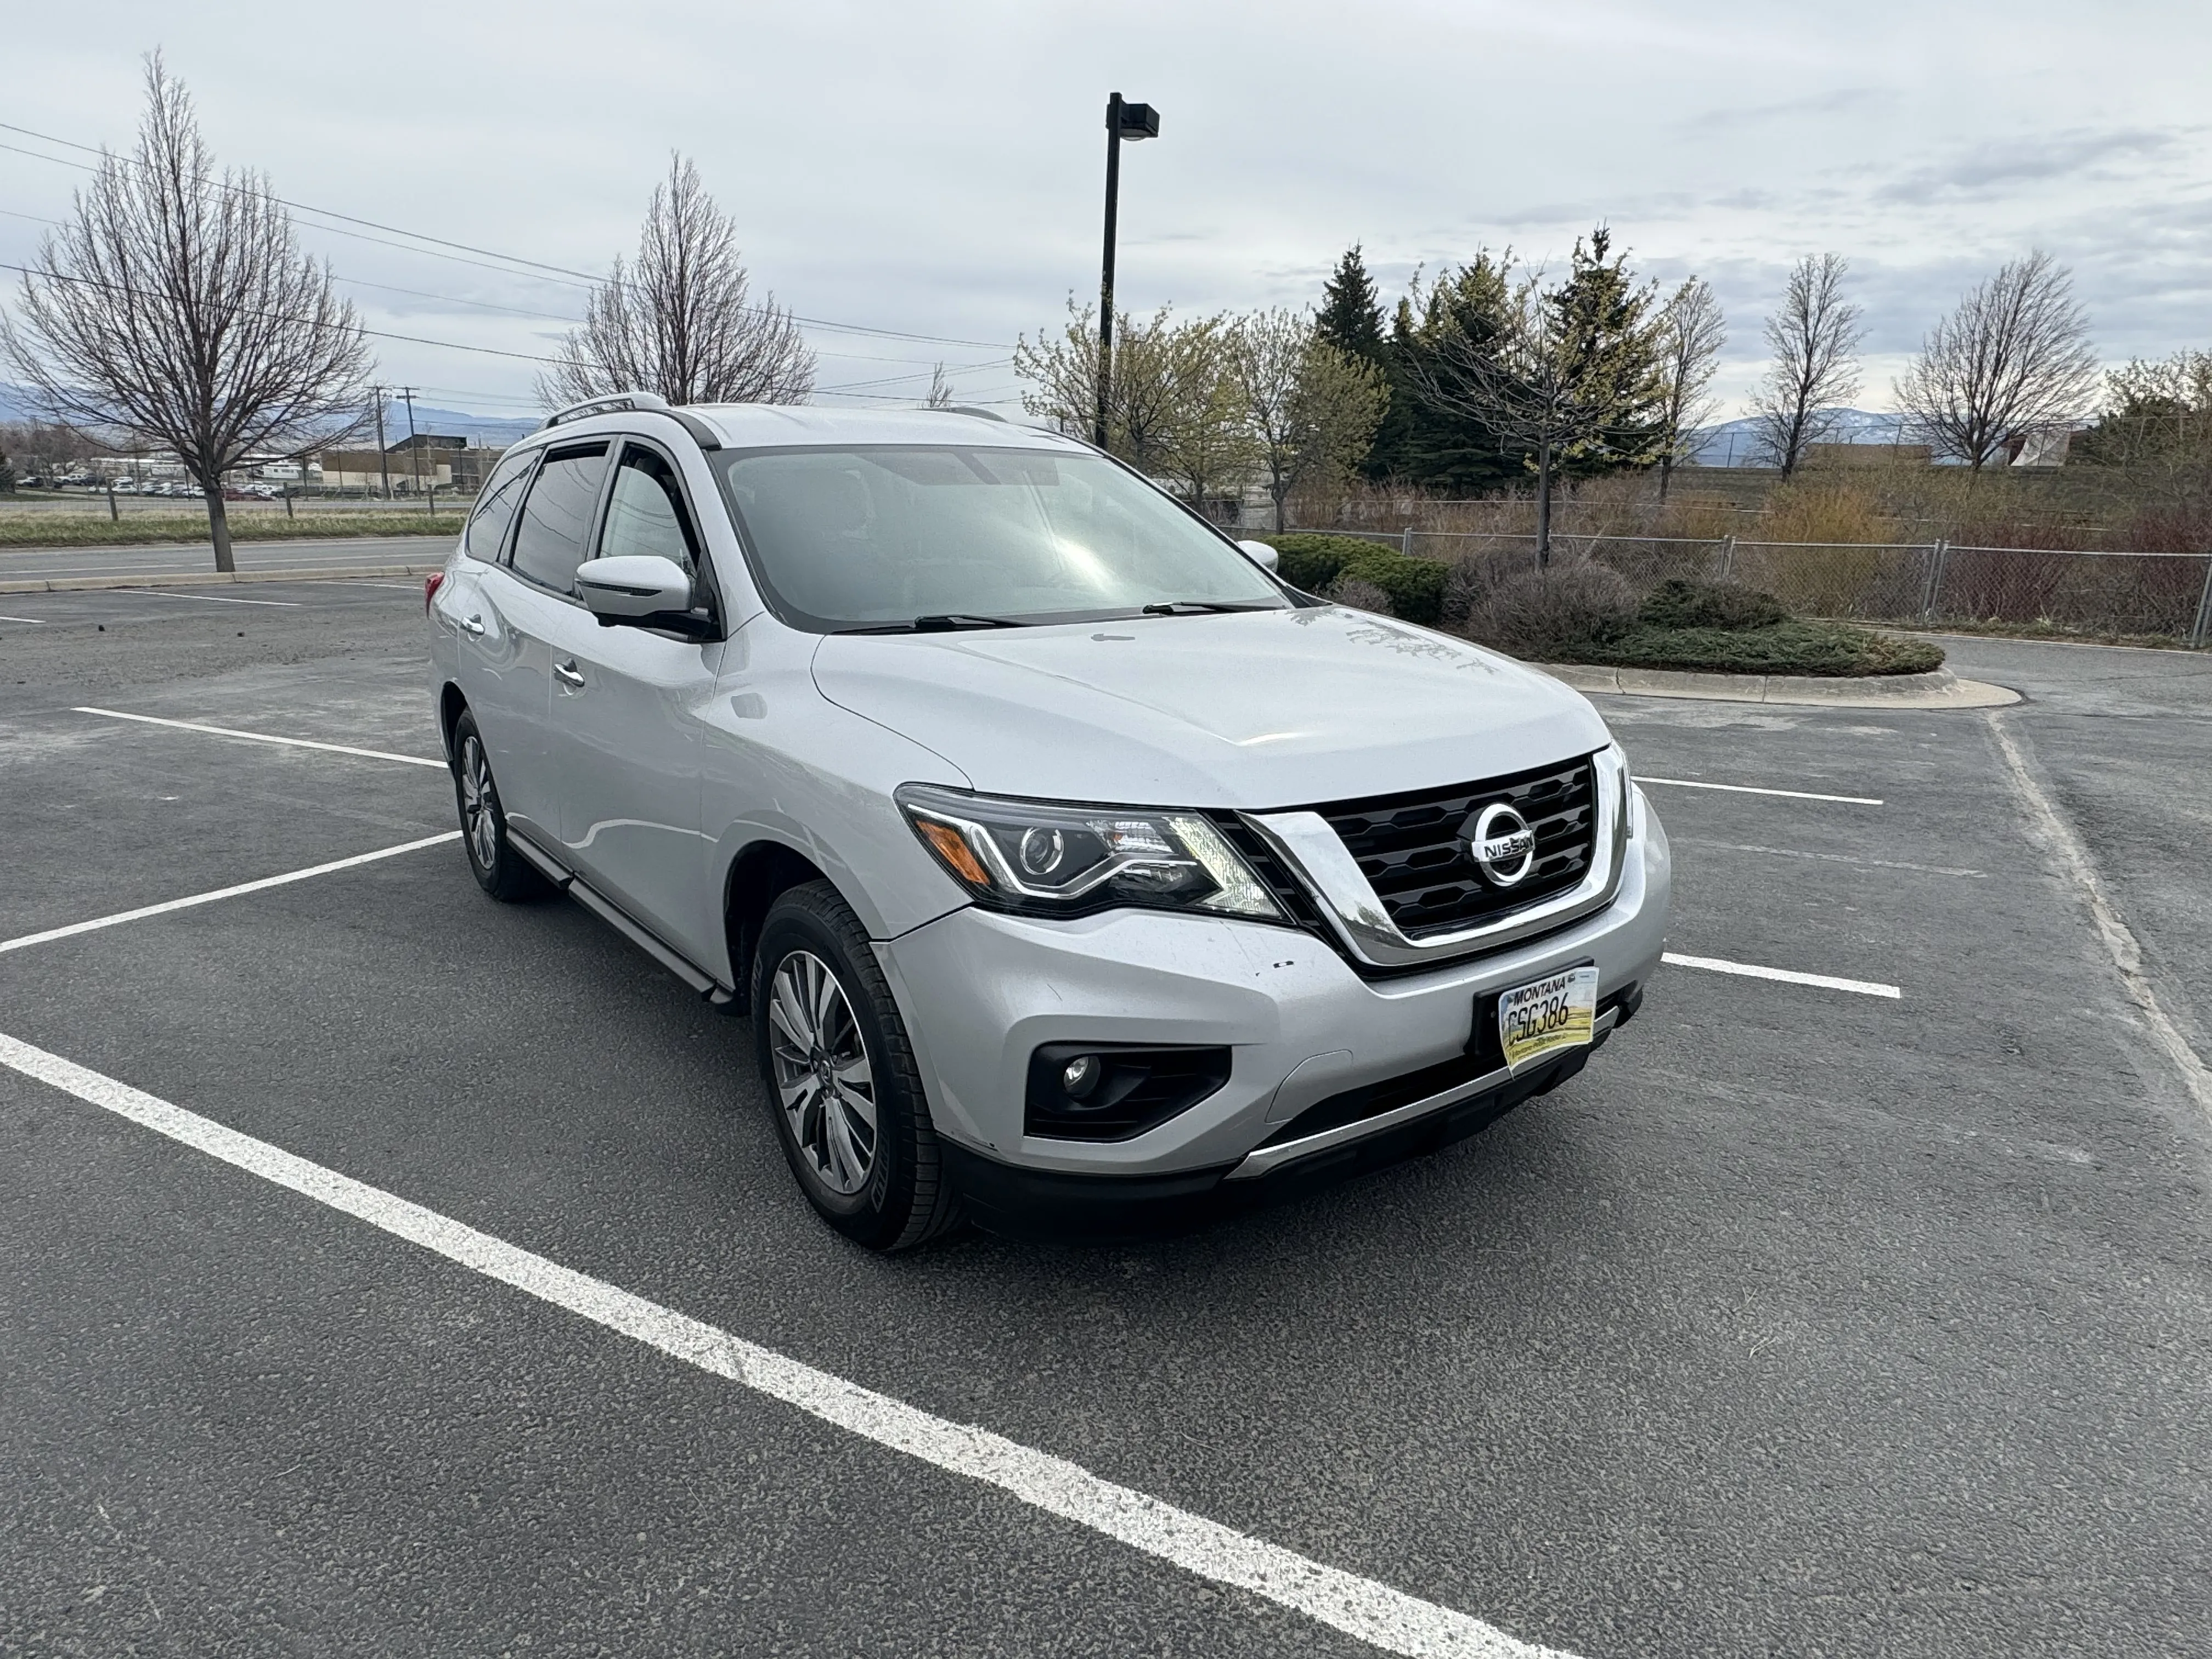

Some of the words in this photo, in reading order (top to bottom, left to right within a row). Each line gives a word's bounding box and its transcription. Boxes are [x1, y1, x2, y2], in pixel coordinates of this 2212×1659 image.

[1483, 834, 1533, 858] NISSAN
[1513, 975, 1566, 1006] MONTANA
[1508, 992, 1569, 1047] CSG386
